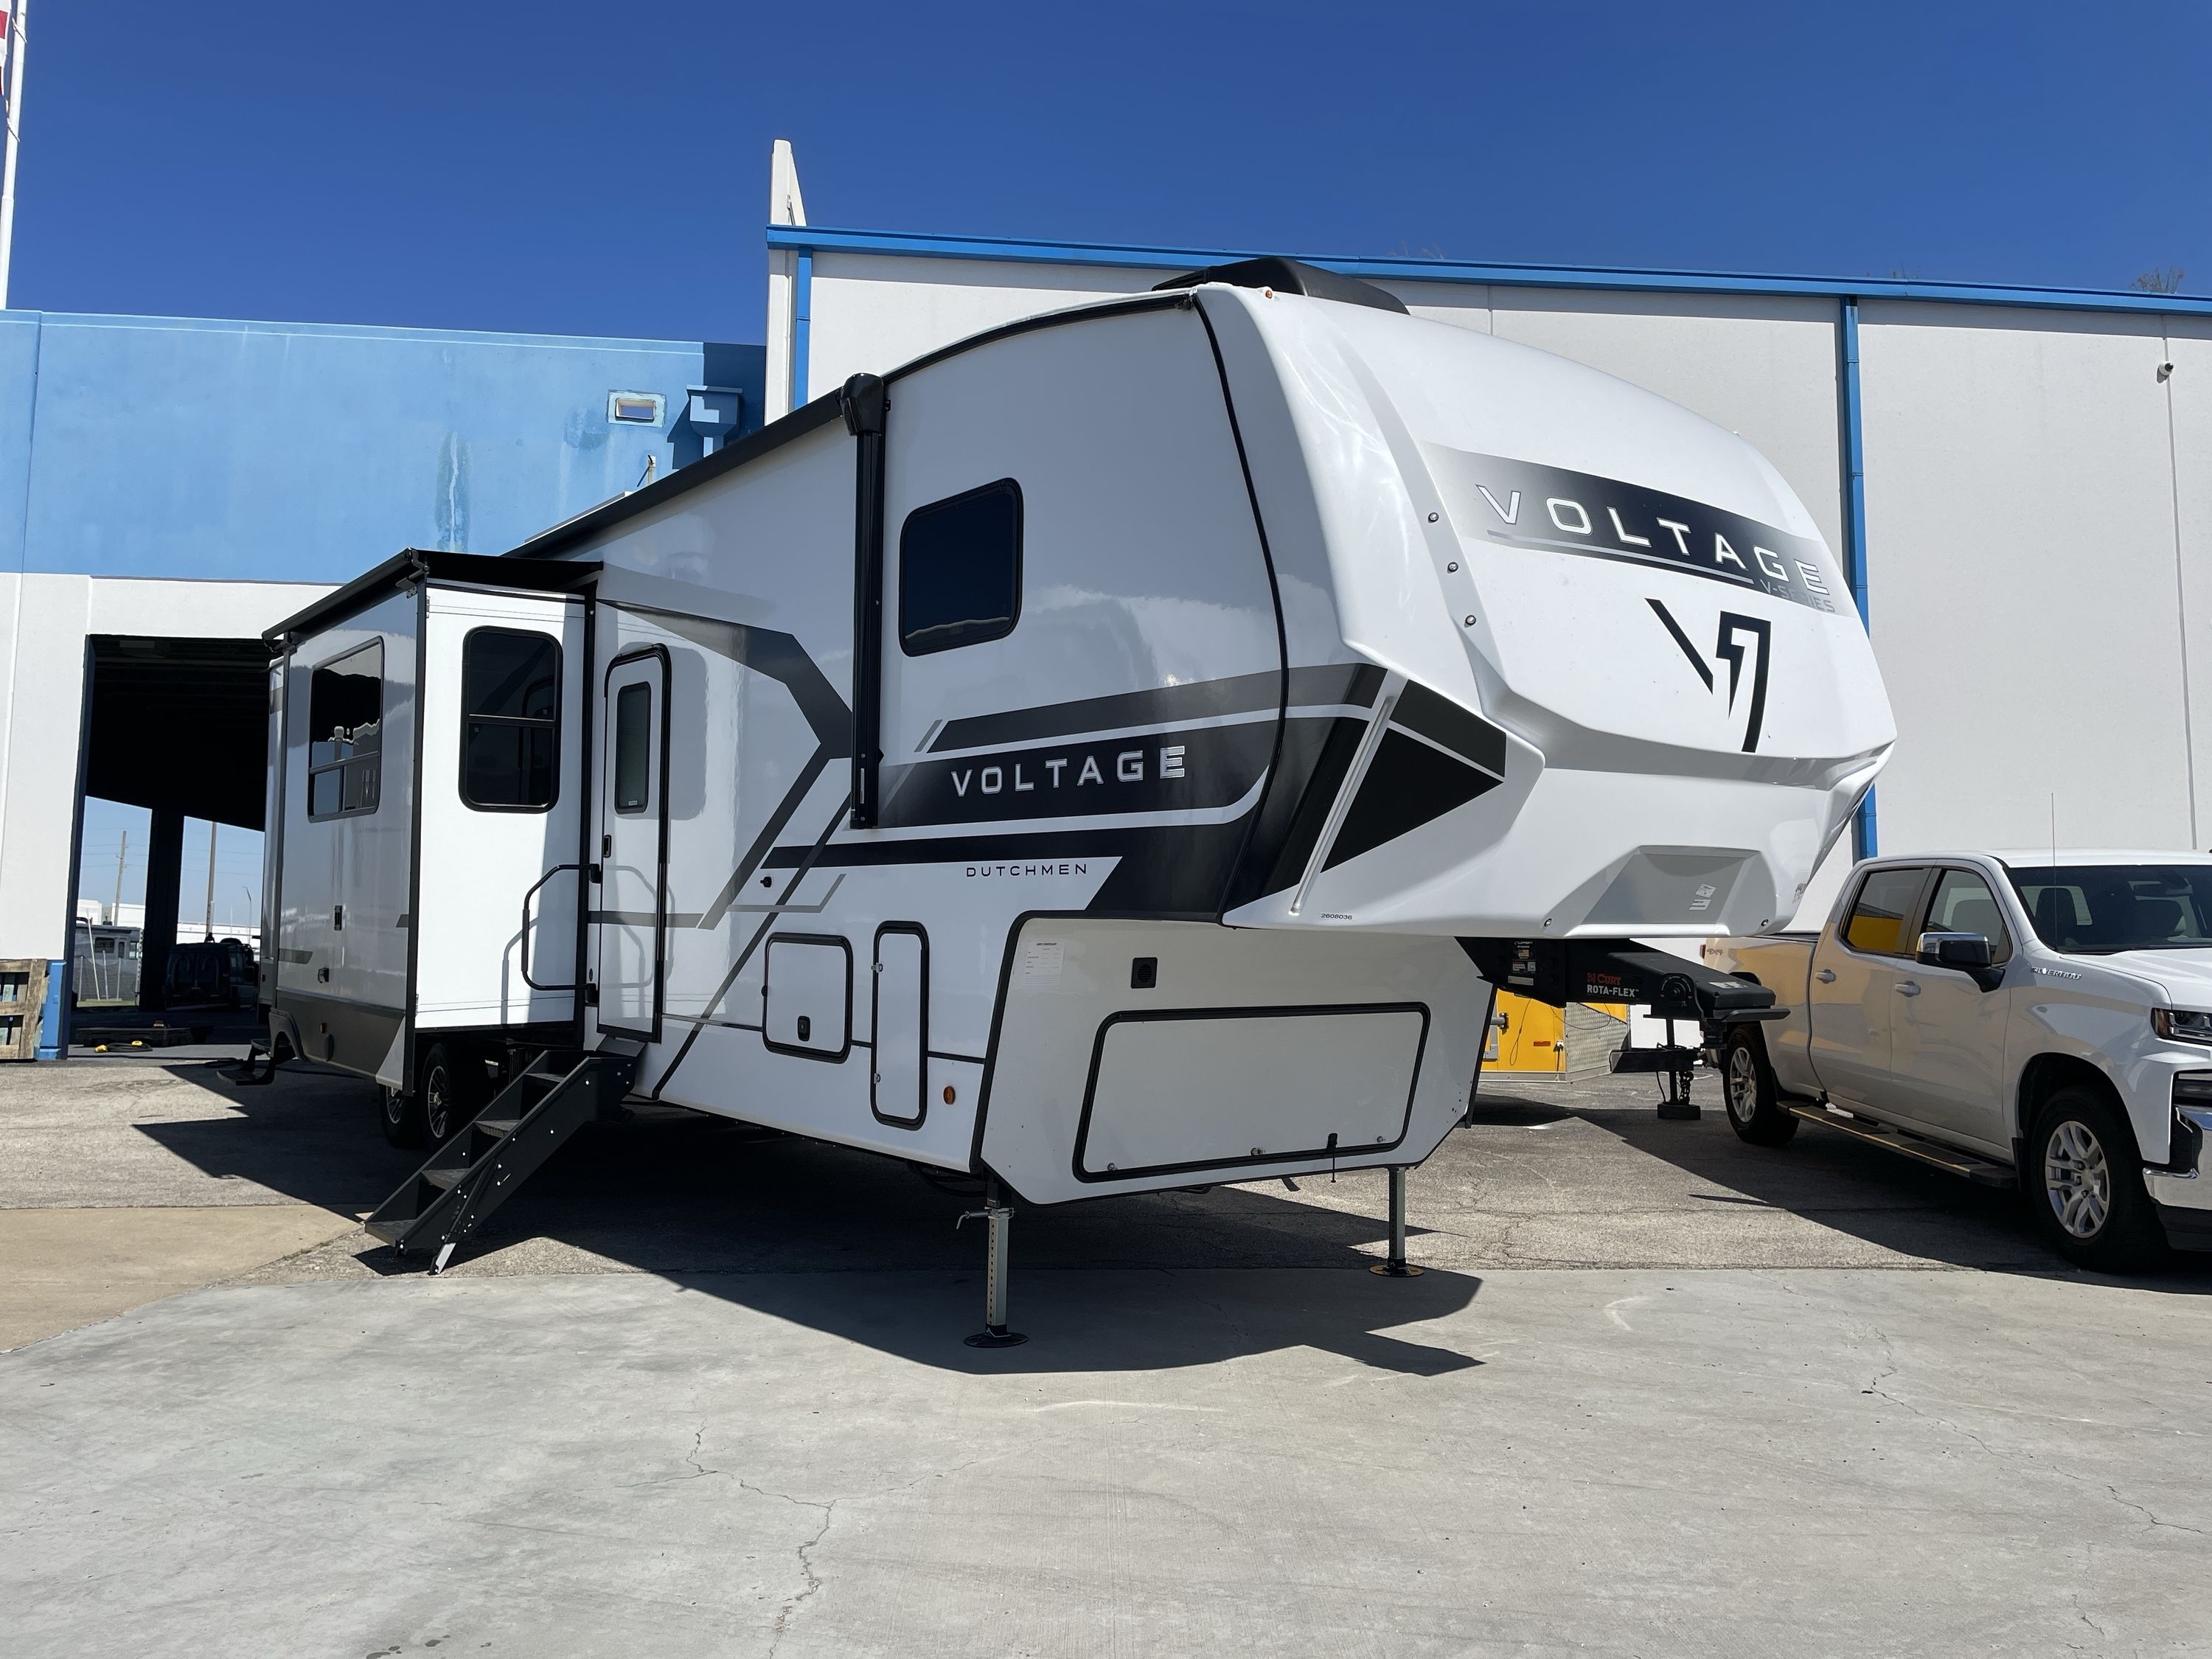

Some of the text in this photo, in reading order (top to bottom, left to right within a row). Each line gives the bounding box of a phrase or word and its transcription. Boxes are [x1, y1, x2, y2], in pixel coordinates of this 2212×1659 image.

[1475, 484, 1830, 596] VOLTAGE
[950, 745, 1186, 798] VOLTAGE
[966, 863, 1087, 877] DUTCHMEN
